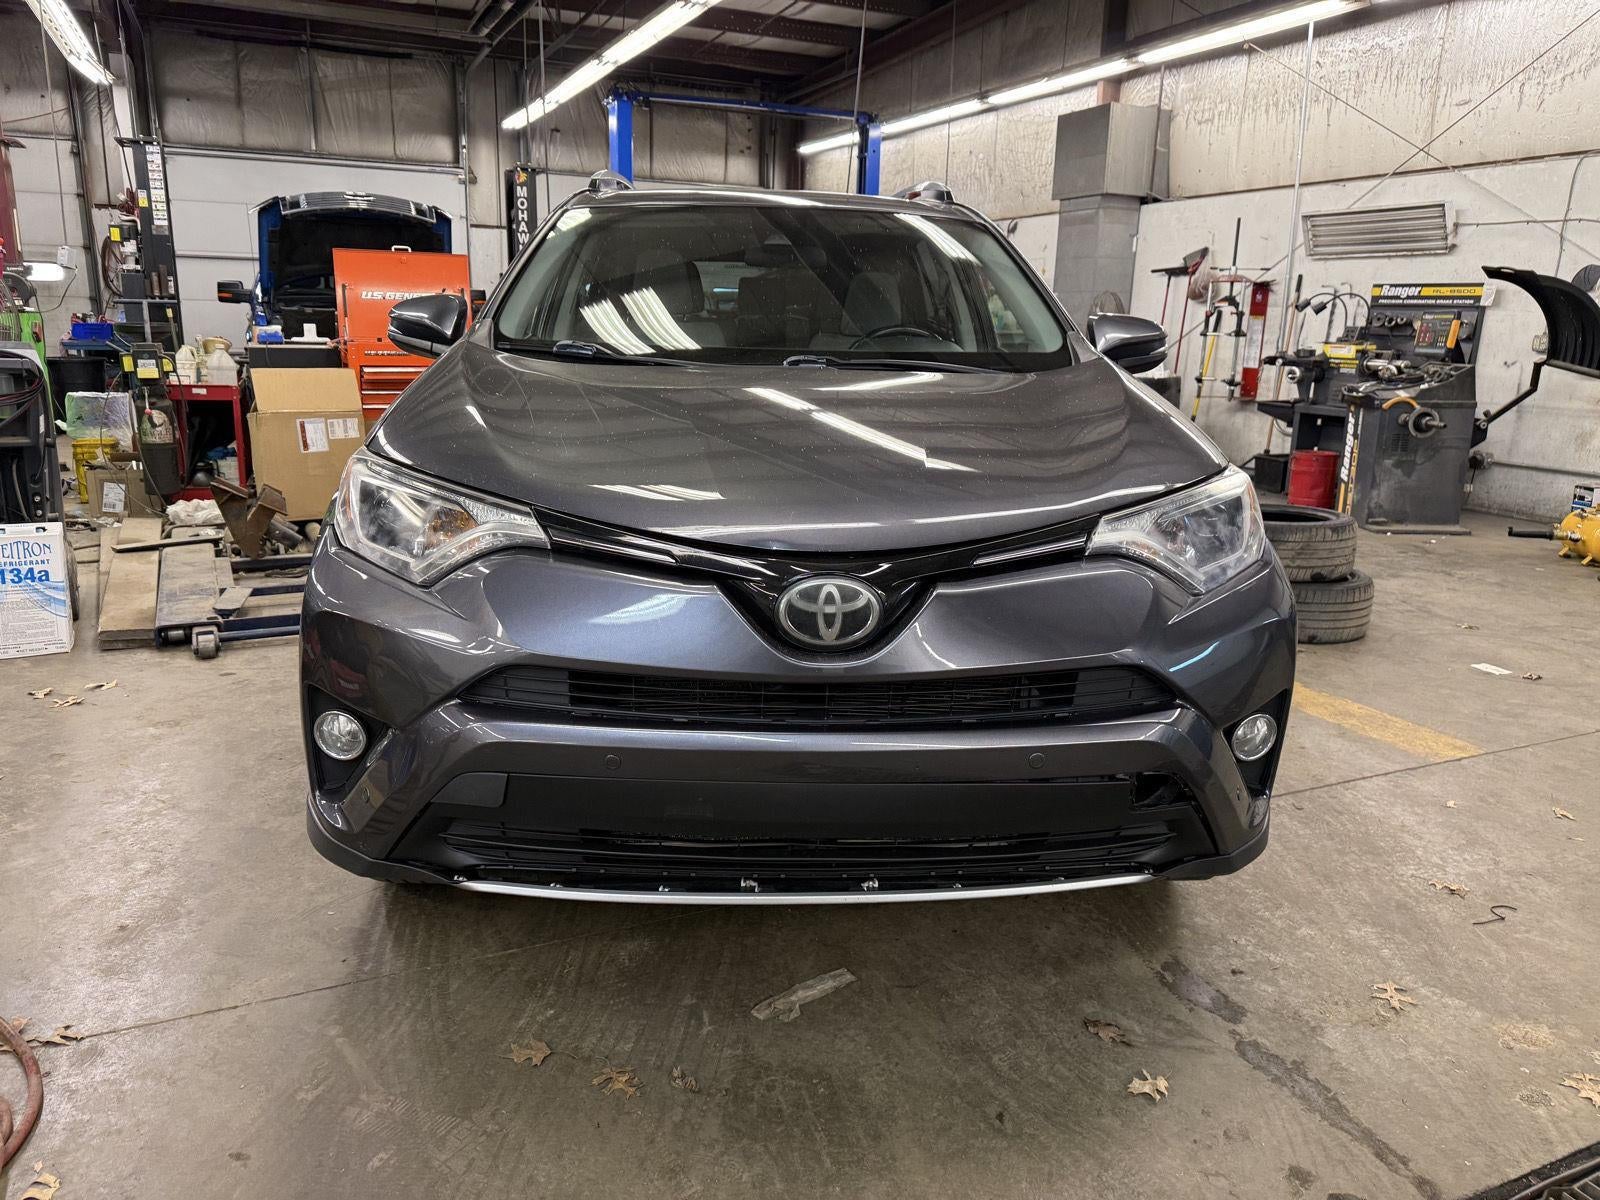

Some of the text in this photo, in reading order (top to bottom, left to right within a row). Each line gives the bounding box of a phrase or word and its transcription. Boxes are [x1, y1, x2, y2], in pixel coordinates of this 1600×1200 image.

[1381, 284, 1421, 298] Ranger
[1340, 412, 1356, 482] Ranger
[0, 540, 52, 560] EITRON
[0, 559, 50, 567] EFRIGERANT
